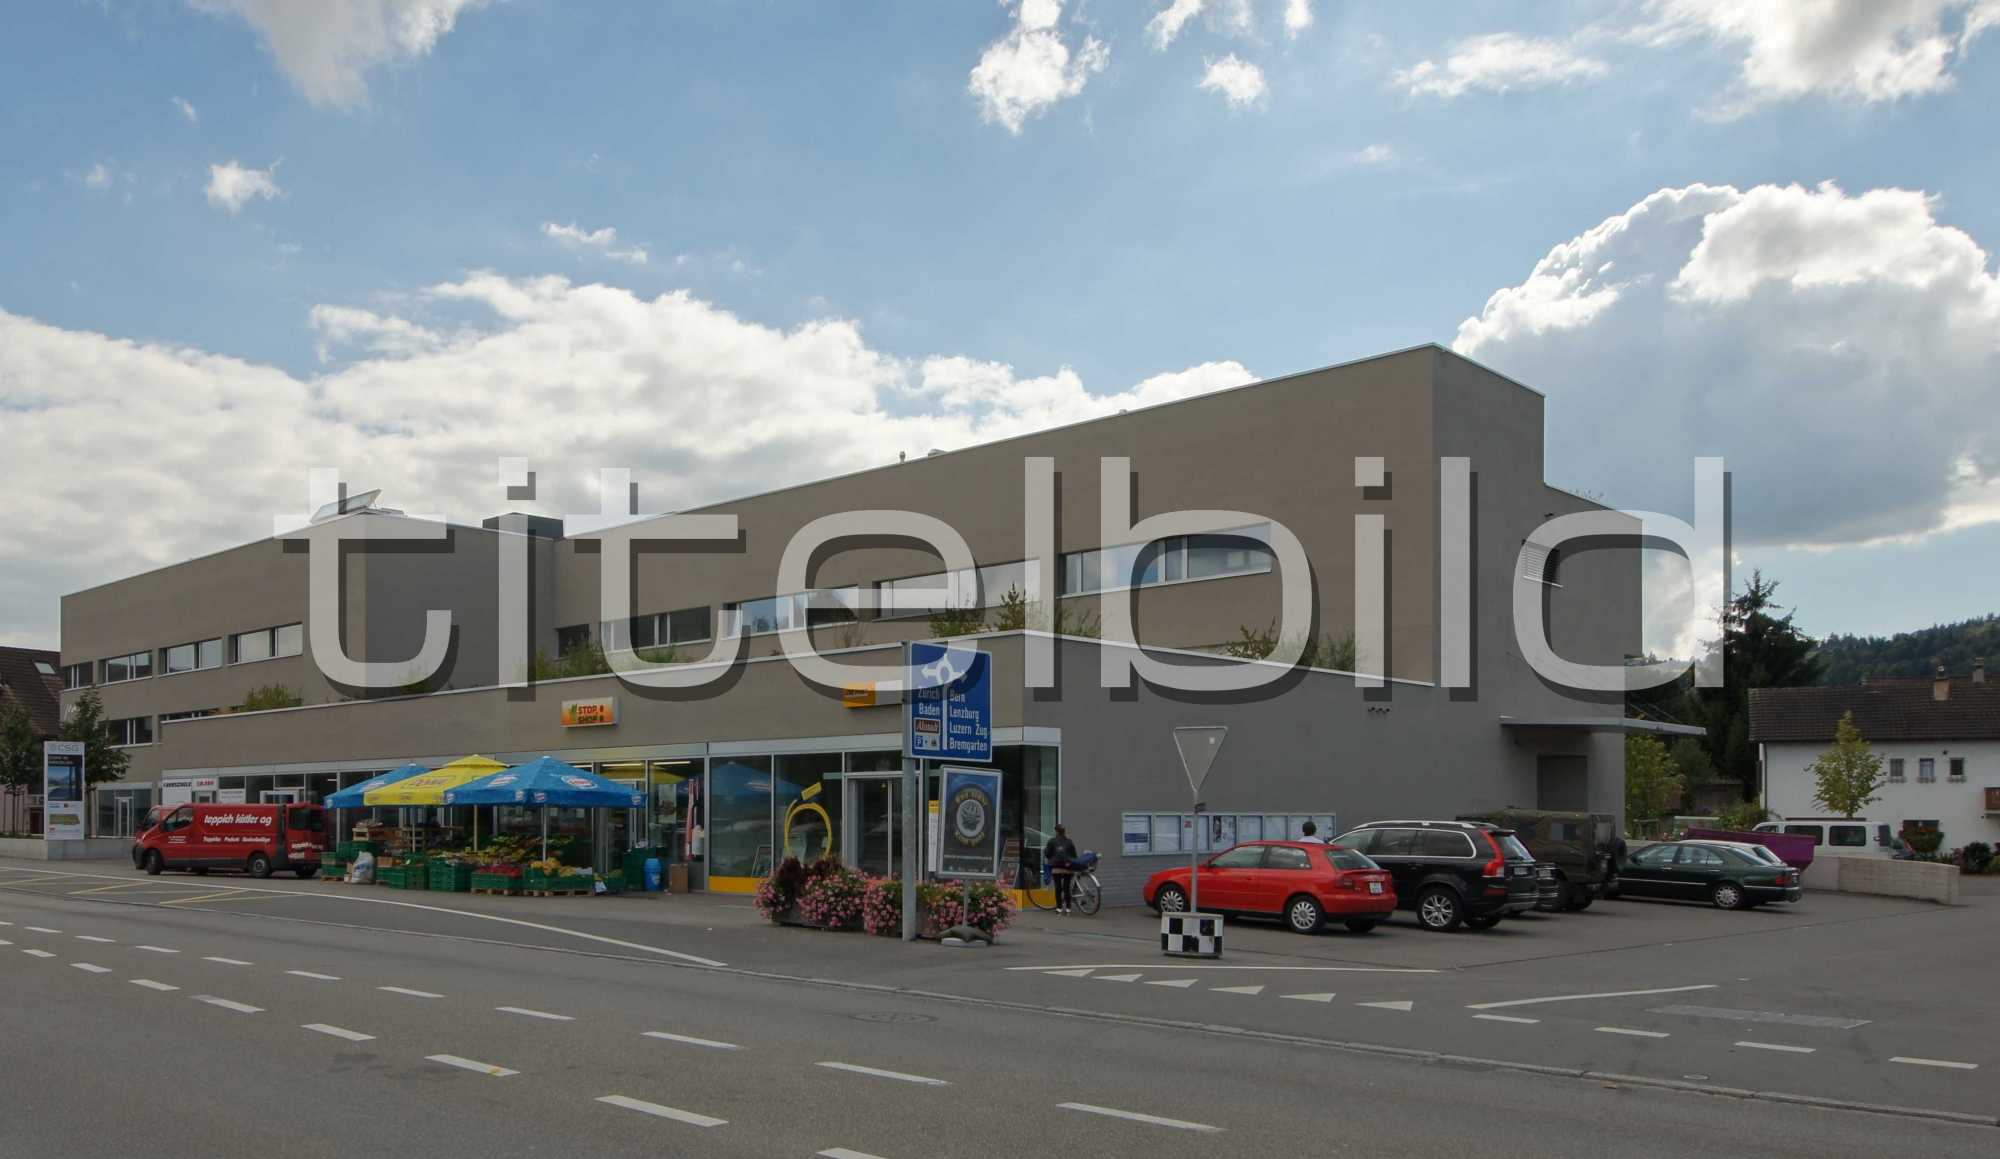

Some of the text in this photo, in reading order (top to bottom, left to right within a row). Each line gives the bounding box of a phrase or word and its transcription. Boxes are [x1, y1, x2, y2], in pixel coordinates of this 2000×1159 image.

[918, 703, 940, 716] Baden
[949, 705, 979, 722] Lenzburg
[949, 721, 988, 739] Luzern Zug
[949, 737, 987, 753] Bremgarten
